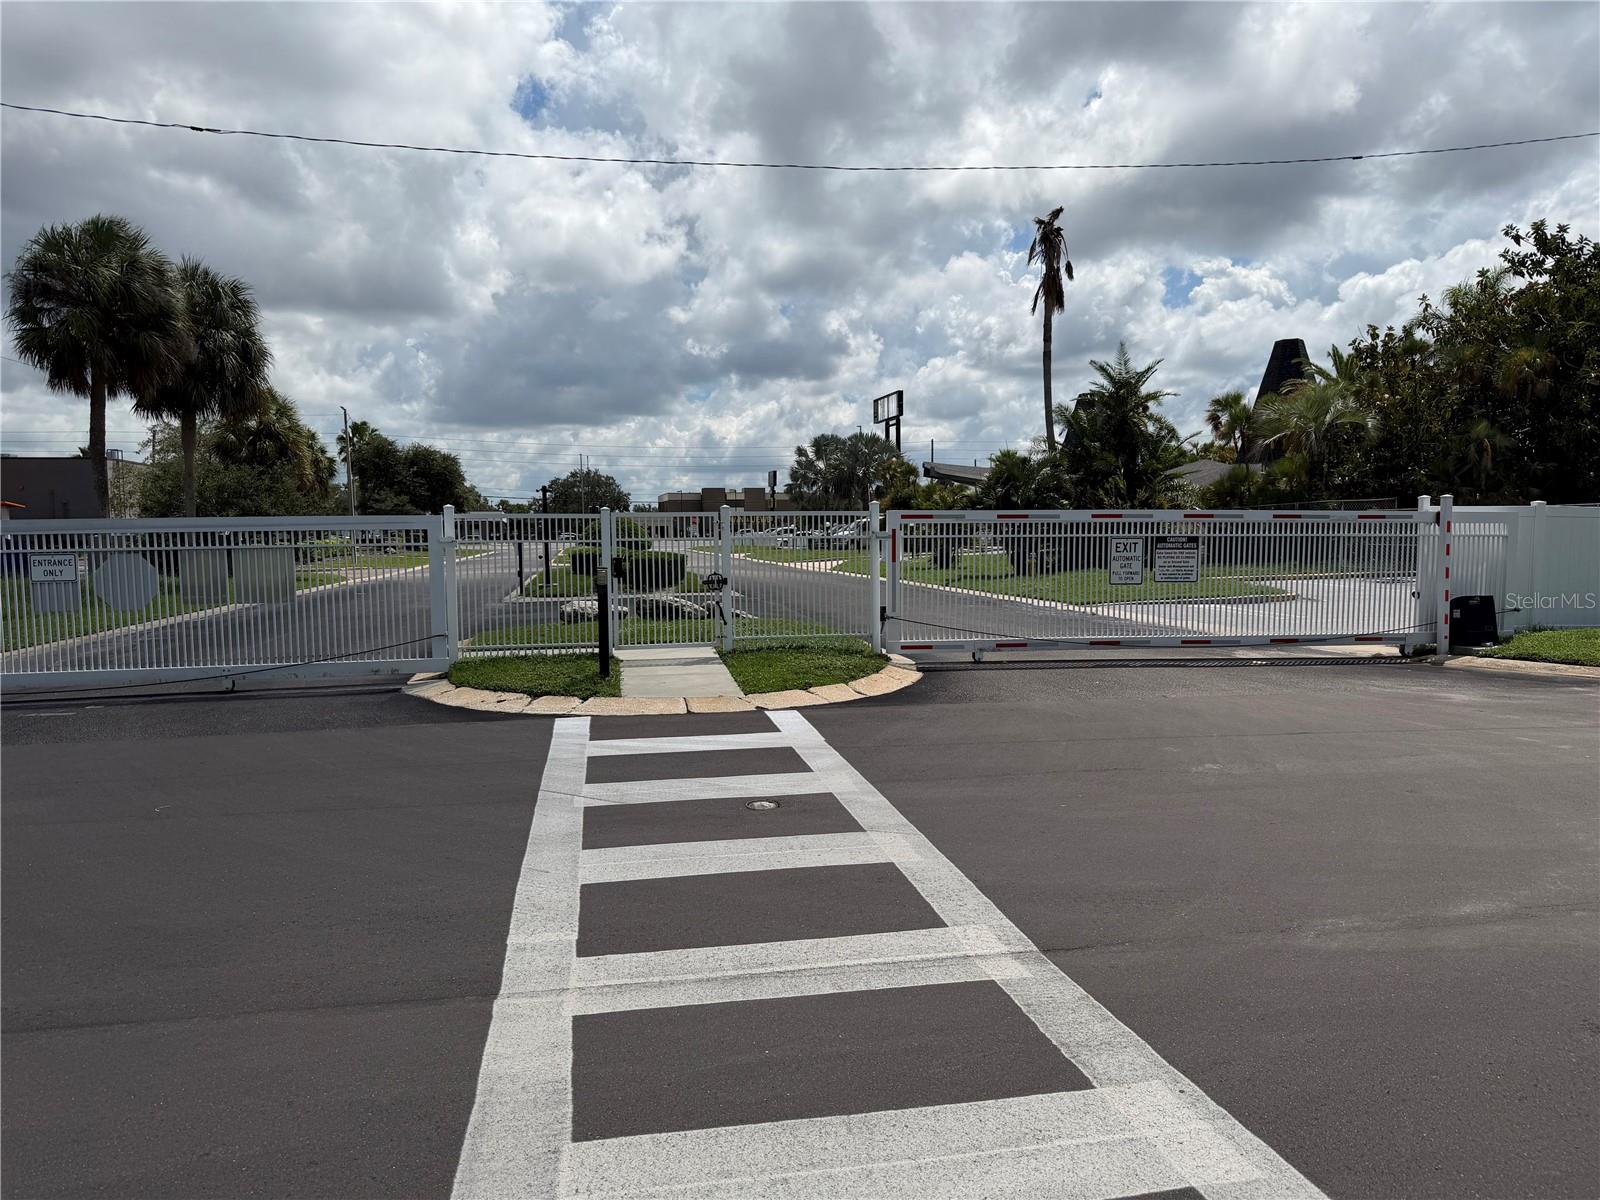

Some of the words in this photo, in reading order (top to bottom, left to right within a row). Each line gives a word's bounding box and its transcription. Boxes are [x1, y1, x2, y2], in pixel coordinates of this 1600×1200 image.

[1115, 542, 1138, 553] EXIT
[32, 558, 73, 567] ENTRANCE
[43, 569, 64, 577] ONLY
